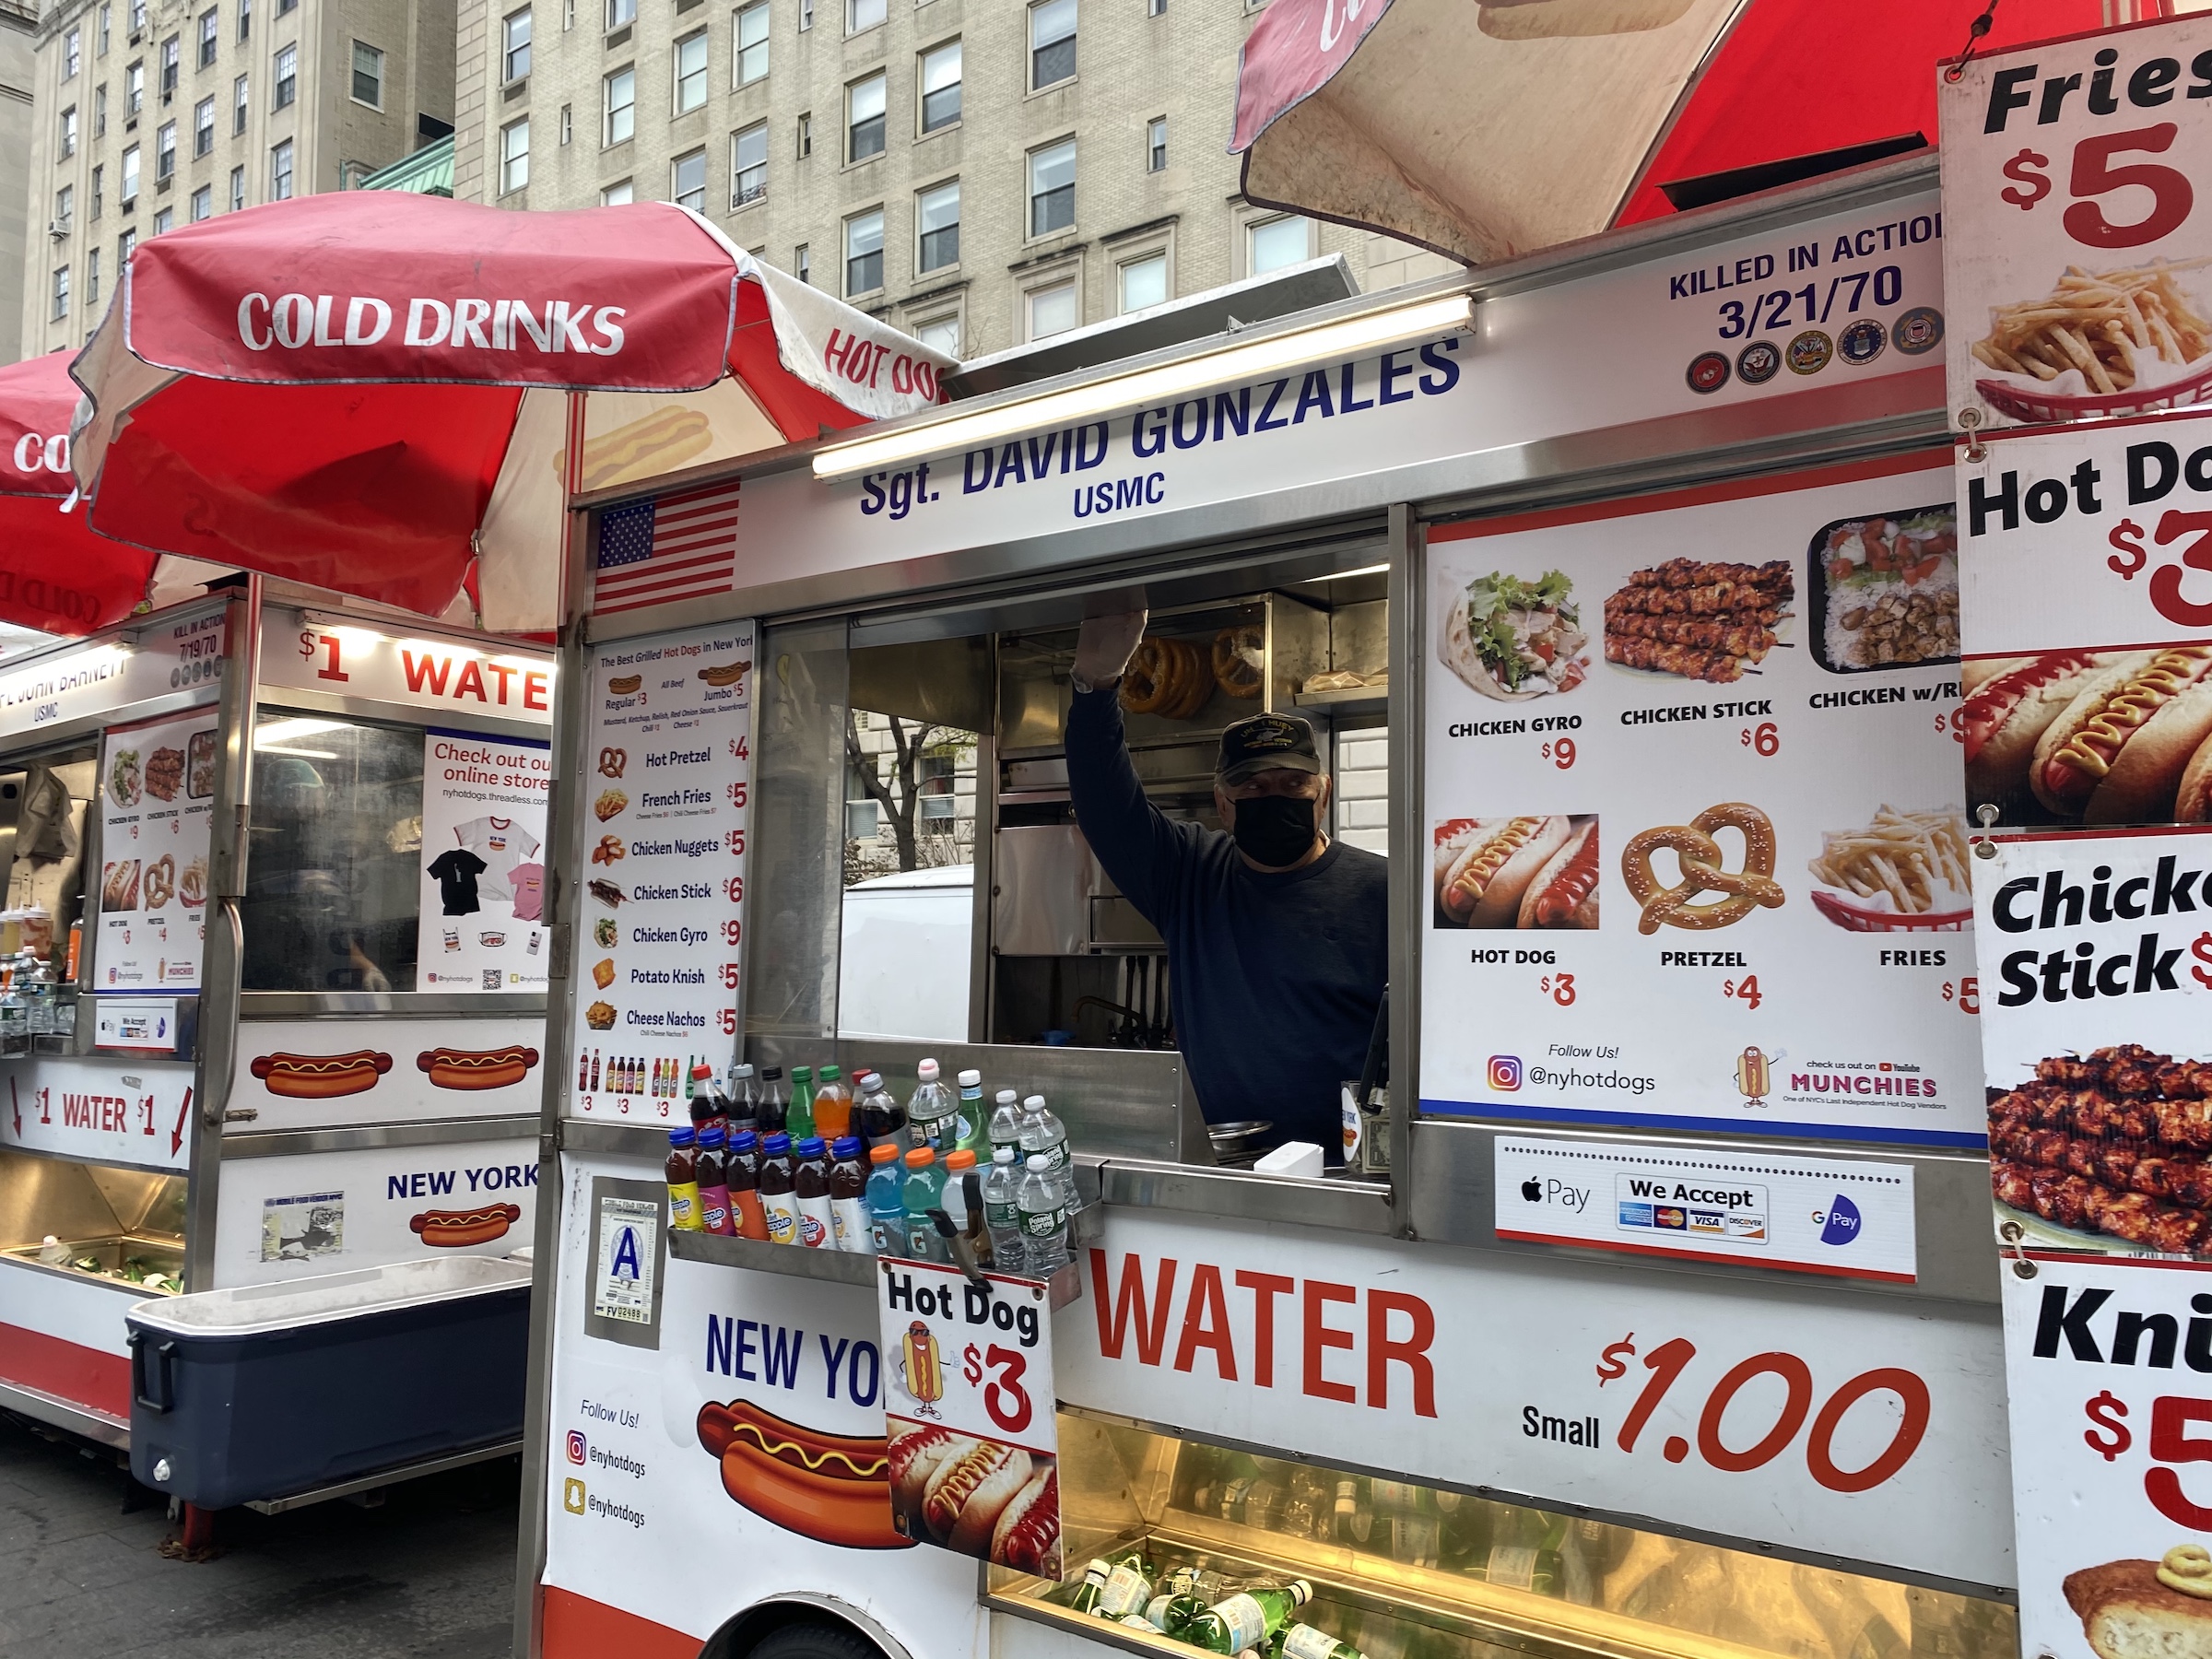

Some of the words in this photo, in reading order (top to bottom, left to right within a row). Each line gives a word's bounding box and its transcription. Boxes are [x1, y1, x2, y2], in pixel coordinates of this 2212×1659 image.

[1983, 46, 2212, 135] Fries
[2001, 123, 2194, 249] $5
[1669, 254, 1775, 300] KILLED
[1788, 242, 1819, 274] IN
[1831, 212, 1942, 263] ACTIO
[1717, 265, 1903, 339] 3/21/70
[237, 292, 394, 351] COLD
[404, 297, 626, 357] DRINKS
[824, 328, 891, 389] HOT
[860, 462, 940, 521] Sgt.
[962, 421, 1109, 495] DAVID
[1131, 338, 1461, 459] GONZALES
[1074, 472, 1165, 518] USMC
[1969, 458, 2101, 537] Hot
[2107, 510, 2212, 628] $3
[180, 634, 217, 663] 7/19/70
[299, 629, 349, 683] $1
[601, 657, 616, 668] The
[617, 653, 634, 666] Best
[636, 648, 662, 663] Grilled
[664, 647, 678, 659] Hot
[681, 645, 701, 657] Dogs
[703, 639, 712, 652] in
[713, 639, 734, 652] New
[670, 678, 685, 689] Beef
[704, 688, 733, 701] Jumbo
[733, 683, 744, 697] $5
[1809, 687, 1906, 709] CHICKEN
[34, 702, 58, 722] USMC
[606, 698, 636, 711] Regular
[637, 692, 647, 705] $3
[1620, 705, 1707, 725] CHICKEN
[1712, 700, 1773, 719] STICK
[1448, 719, 1525, 737] CHICKEN
[1531, 715, 1583, 733] GYRO
[1741, 722, 1780, 757] $6
[434, 742, 491, 765] Check
[496, 754, 527, 768] out
[646, 753, 669, 768] Hot
[670, 747, 712, 766] Pretzel
[728, 735, 749, 761] $4
[1541, 737, 1576, 770] $9
[443, 766, 499, 785] online
[502, 773, 549, 791] store
[642, 790, 682, 807] French
[683, 789, 712, 805] Fries
[726, 782, 747, 808] $5
[631, 841, 672, 856] Chicken
[675, 839, 719, 858] Nuggets
[724, 830, 745, 855] $5
[634, 885, 678, 900] Chicken
[680, 883, 712, 899] Stick
[722, 877, 743, 902] $6
[1993, 854, 2212, 934] Chick
[633, 927, 677, 943] Chicken
[680, 927, 708, 947] Gyro
[720, 920, 741, 946] $9
[1471, 949, 1510, 964] HOT
[1515, 950, 1556, 965] DOG
[1660, 951, 1747, 967] PRETZEL
[1880, 949, 1947, 967] FRIES
[1997, 932, 2185, 1007] Stick
[630, 969, 670, 984] Potato
[672, 969, 705, 983] Knish
[718, 963, 738, 990] $5
[1540, 972, 1576, 1006] $3
[1724, 974, 1762, 1010] $4
[1942, 977, 1981, 1015] $5
[627, 1010, 664, 1026] Cheese
[666, 1010, 706, 1027] Nachos
[716, 1008, 736, 1035] $5
[1548, 1044, 1593, 1058] Follow
[1596, 1046, 1619, 1059] Us!
[1529, 1066, 1655, 1094] @nyhotdogs
[1806, 1060, 1833, 1069] check
[1893, 1064, 1921, 1073] YouTube
[1791, 1073, 1937, 1098] MUNCHIES
[34, 1087, 52, 1125] $1
[63, 1092, 127, 1134] WATER
[137, 1094, 156, 1136] $1
[581, 1095, 593, 1112] $3
[617, 1098, 629, 1114] $3
[656, 1100, 669, 1117] $3
[1842, 1099, 1886, 1108] Independent
[1900, 1100, 1916, 1110] Dog
[1918, 1102, 1947, 1111] Vendors
[386, 1170, 456, 1200] NEW
[465, 1163, 540, 1193] YORK
[1630, 1180, 1666, 1199] We
[1673, 1183, 1754, 1210] Accept
[1547, 1179, 1591, 1214] Pay
[1028, 1212, 1053, 1226] Poland
[1030, 1219, 1055, 1234] Spring
[1694, 1216, 1720, 1227] VISA
[1729, 1218, 1762, 1228] DISCOVER
[1812, 1210, 1826, 1225] G
[1831, 1211, 1858, 1231] Pay
[611, 1227, 640, 1280] A
[888, 1272, 953, 1320] Hot
[964, 1283, 1039, 1347] Dog
[1088, 1247, 1439, 1419] WATER
[706, 1313, 804, 1390] NEW
[819, 1335, 887, 1410] YO
[963, 1342, 1033, 1433] $3
[581, 1400, 618, 1425] Follow
[619, 1409, 640, 1430] Us!
[1522, 1406, 1599, 1451] Small
[1596, 1333, 1932, 1493] $1.00
[589, 1444, 645, 1479] @nyhotdogs
[588, 1494, 645, 1529] @nyhotdogs
